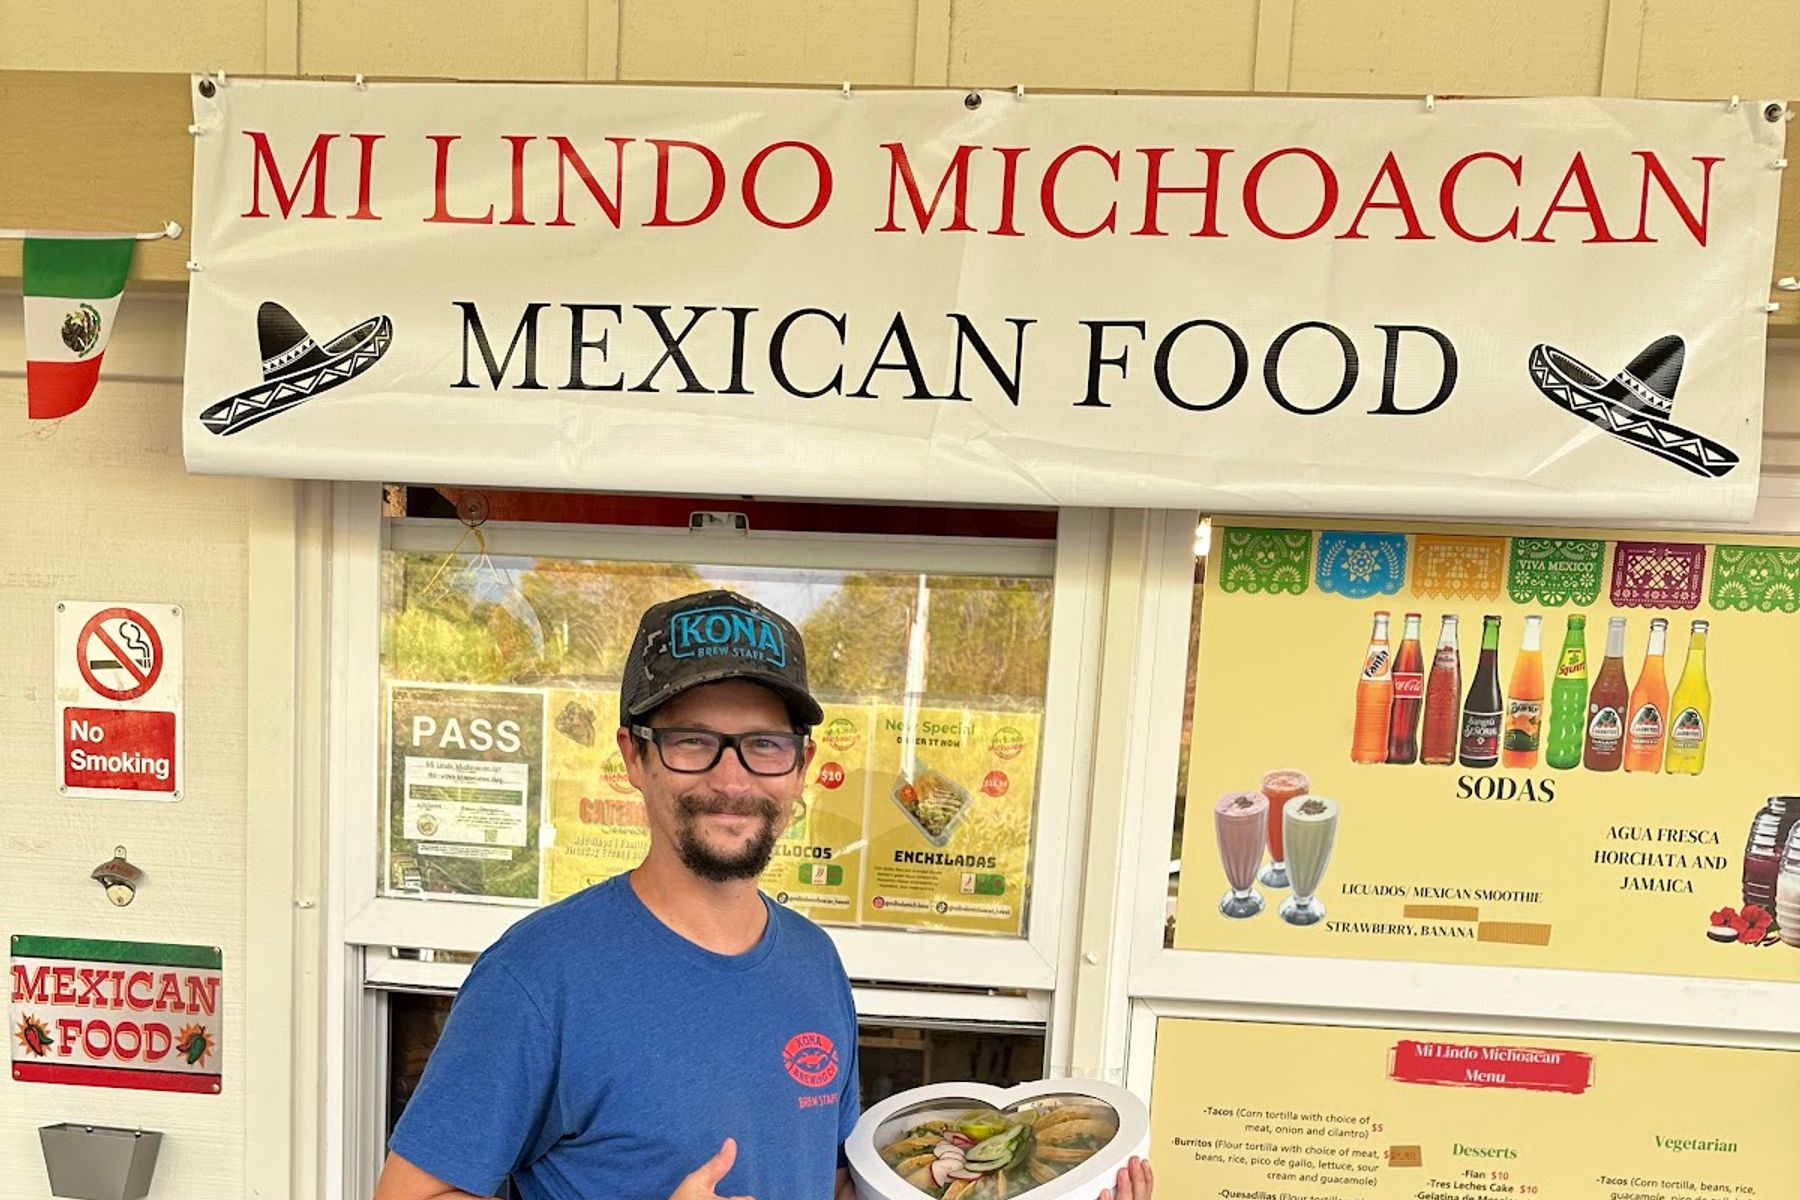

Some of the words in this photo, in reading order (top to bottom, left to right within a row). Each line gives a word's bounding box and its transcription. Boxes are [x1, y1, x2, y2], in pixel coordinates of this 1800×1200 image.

[241, 130, 384, 221] MI
[423, 133, 834, 230] LINDO
[874, 142, 1725, 248] MICHOACAN
[450, 301, 1037, 407] MEXICAN
[1072, 318, 1459, 416] FOOD
[1519, 559, 1546, 570] VIVA
[678, 613, 780, 657] KONA
[698, 647, 729, 658] BREW
[732, 647, 765, 661] STAFF
[70, 719, 104, 744] No
[412, 715, 521, 753] PASS
[70, 748, 170, 781] Smoking
[1456, 775, 1556, 803] SODAS
[1606, 826, 1652, 841] AGUA
[1657, 828, 1720, 845] FRESCA
[894, 850, 997, 869] ENCHILADAS
[1594, 850, 1687, 868] HORCHATA
[1691, 855, 1727, 870] AND
[1342, 883, 1410, 898] LICUADOS/
[1413, 886, 1471, 901] MEXICAN
[1474, 889, 1543, 903] SMOOTHIE
[1620, 876, 1694, 893] JAMAICA
[1325, 921, 1417, 937] STRAWBERRY,
[1420, 925, 1474, 939] BANANA
[11, 964, 220, 1014] MEXICAN
[55, 1018, 174, 1063] FOOD
[795, 1034, 823, 1048] KONA
[1415, 1044, 1433, 1057] Mi
[1436, 1045, 1478, 1060] Lindo
[1481, 1047, 1560, 1064] Michoacan
[1465, 1069, 1506, 1083] Menu
[1265, 1110, 1298, 1120] tortilla
[1300, 1112, 1323, 1122] with
[1325, 1113, 1357, 1125] choice
[1358, 1115, 1370, 1125] of
[1274, 1125, 1304, 1135] onion
[1306, 1126, 1326, 1136] and
[1245, 1142, 1278, 1152] tortilla
[1280, 1144, 1303, 1153] with
[1304, 1146, 1336, 1156] choice
[1337, 1147, 1350, 1157] of
[1453, 1143, 1518, 1160] Desserts
[1655, 1135, 1738, 1153] Vegetarian
[1250, 1157, 1272, 1166] pico
[1273, 1157, 1286, 1167] de
[1357, 1164, 1380, 1172] sour
[1267, 1172, 1297, 1180] cream
[1298, 1173, 1318, 1182] and
[1461, 1169, 1486, 1180] -Flan
[1491, 1171, 1509, 1181] $10
[1427, 1178, 1451, 1189] -Tres
[1453, 1180, 1487, 1191] Leches
[1489, 1183, 1514, 1193] Cake
[1519, 1184, 1538, 1194] $10
